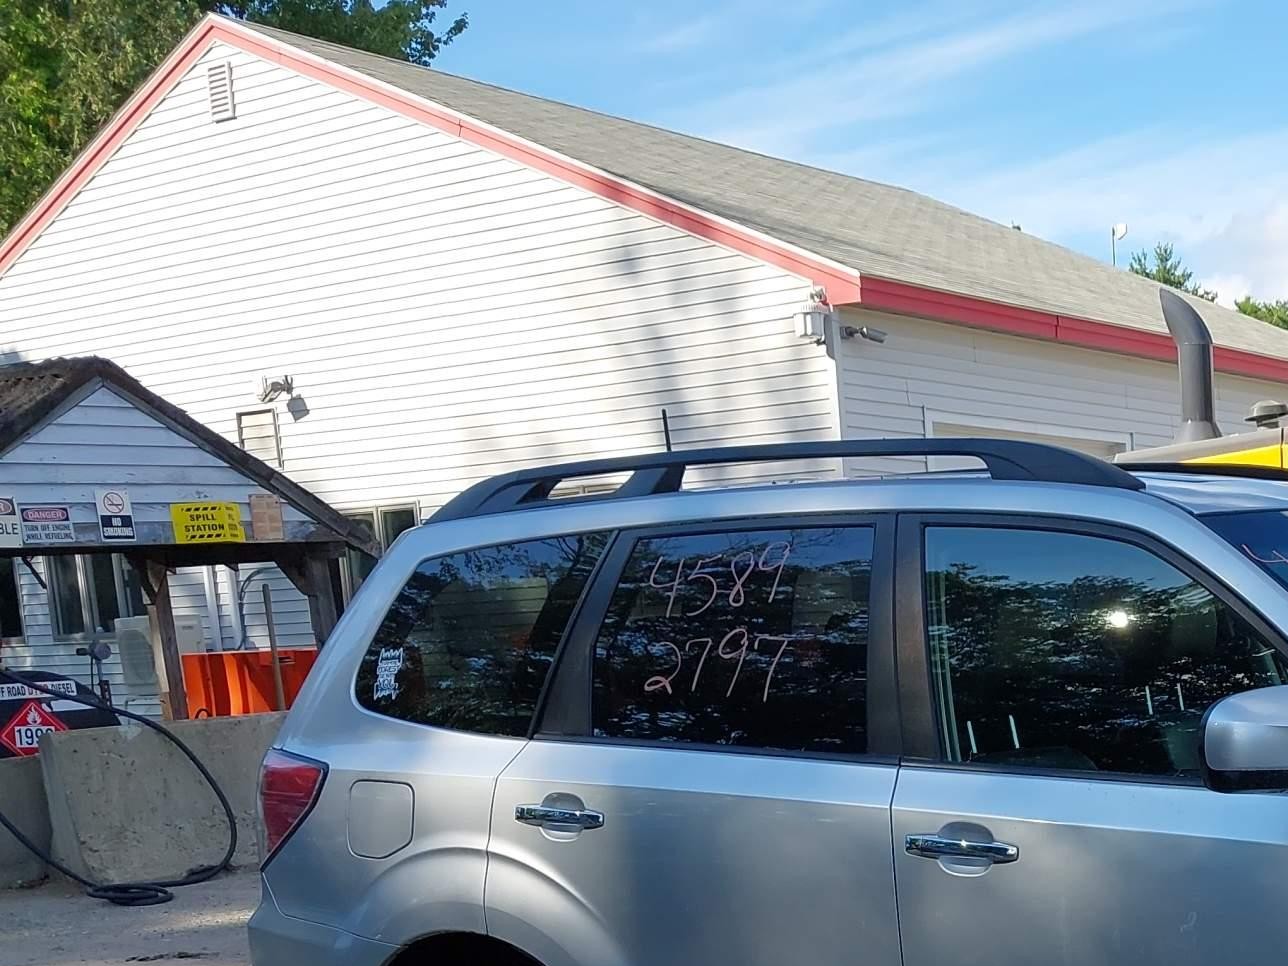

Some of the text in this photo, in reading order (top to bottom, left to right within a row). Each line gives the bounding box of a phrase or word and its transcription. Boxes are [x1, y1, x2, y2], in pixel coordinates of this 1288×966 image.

[27, 511, 62, 519] DANGER
[189, 513, 216, 521] SPILL
[112, 517, 121, 526] NO
[103, 528, 133, 536] SMOKING
[184, 524, 225, 533] STATION
[650, 541, 790, 618] 4589
[644, 628, 788, 702] 2797
[7, 685, 27, 697] ROAD
